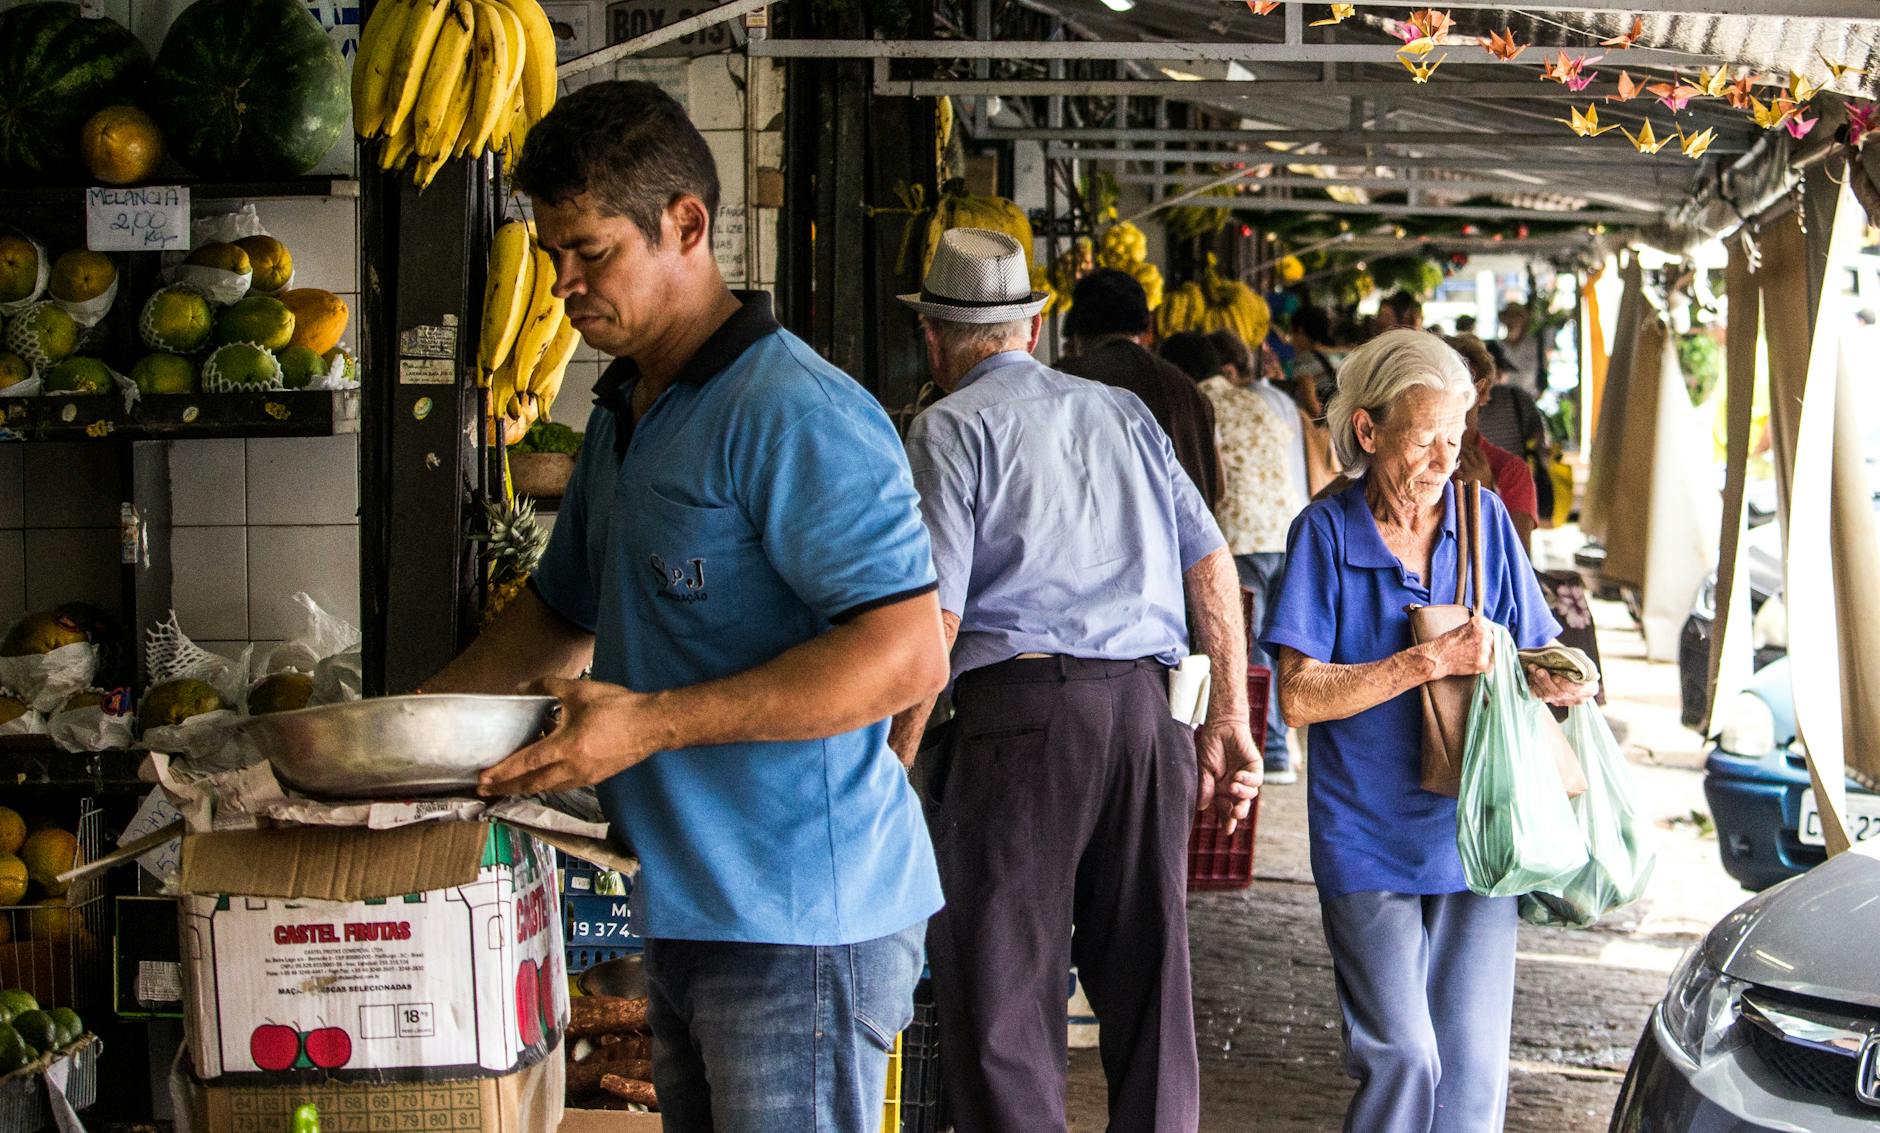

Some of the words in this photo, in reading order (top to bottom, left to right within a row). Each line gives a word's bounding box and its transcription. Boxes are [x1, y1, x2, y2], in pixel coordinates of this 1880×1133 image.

[90, 188, 179, 206] MELANCIA
[111, 211, 168, 236] 2,00
[274, 924, 340, 945] CASTEL
[344, 921, 412, 943] FRUTAS
[594, 922, 641, 938] 374
[349, 984, 412, 993] SELECIONADAS
[403, 1009, 420, 1023] 18
[373, 1094, 389, 1107] 69
[430, 1093, 445, 1106] 71
[457, 1092, 474, 1105] 72
[459, 1112, 475, 1125] 81
